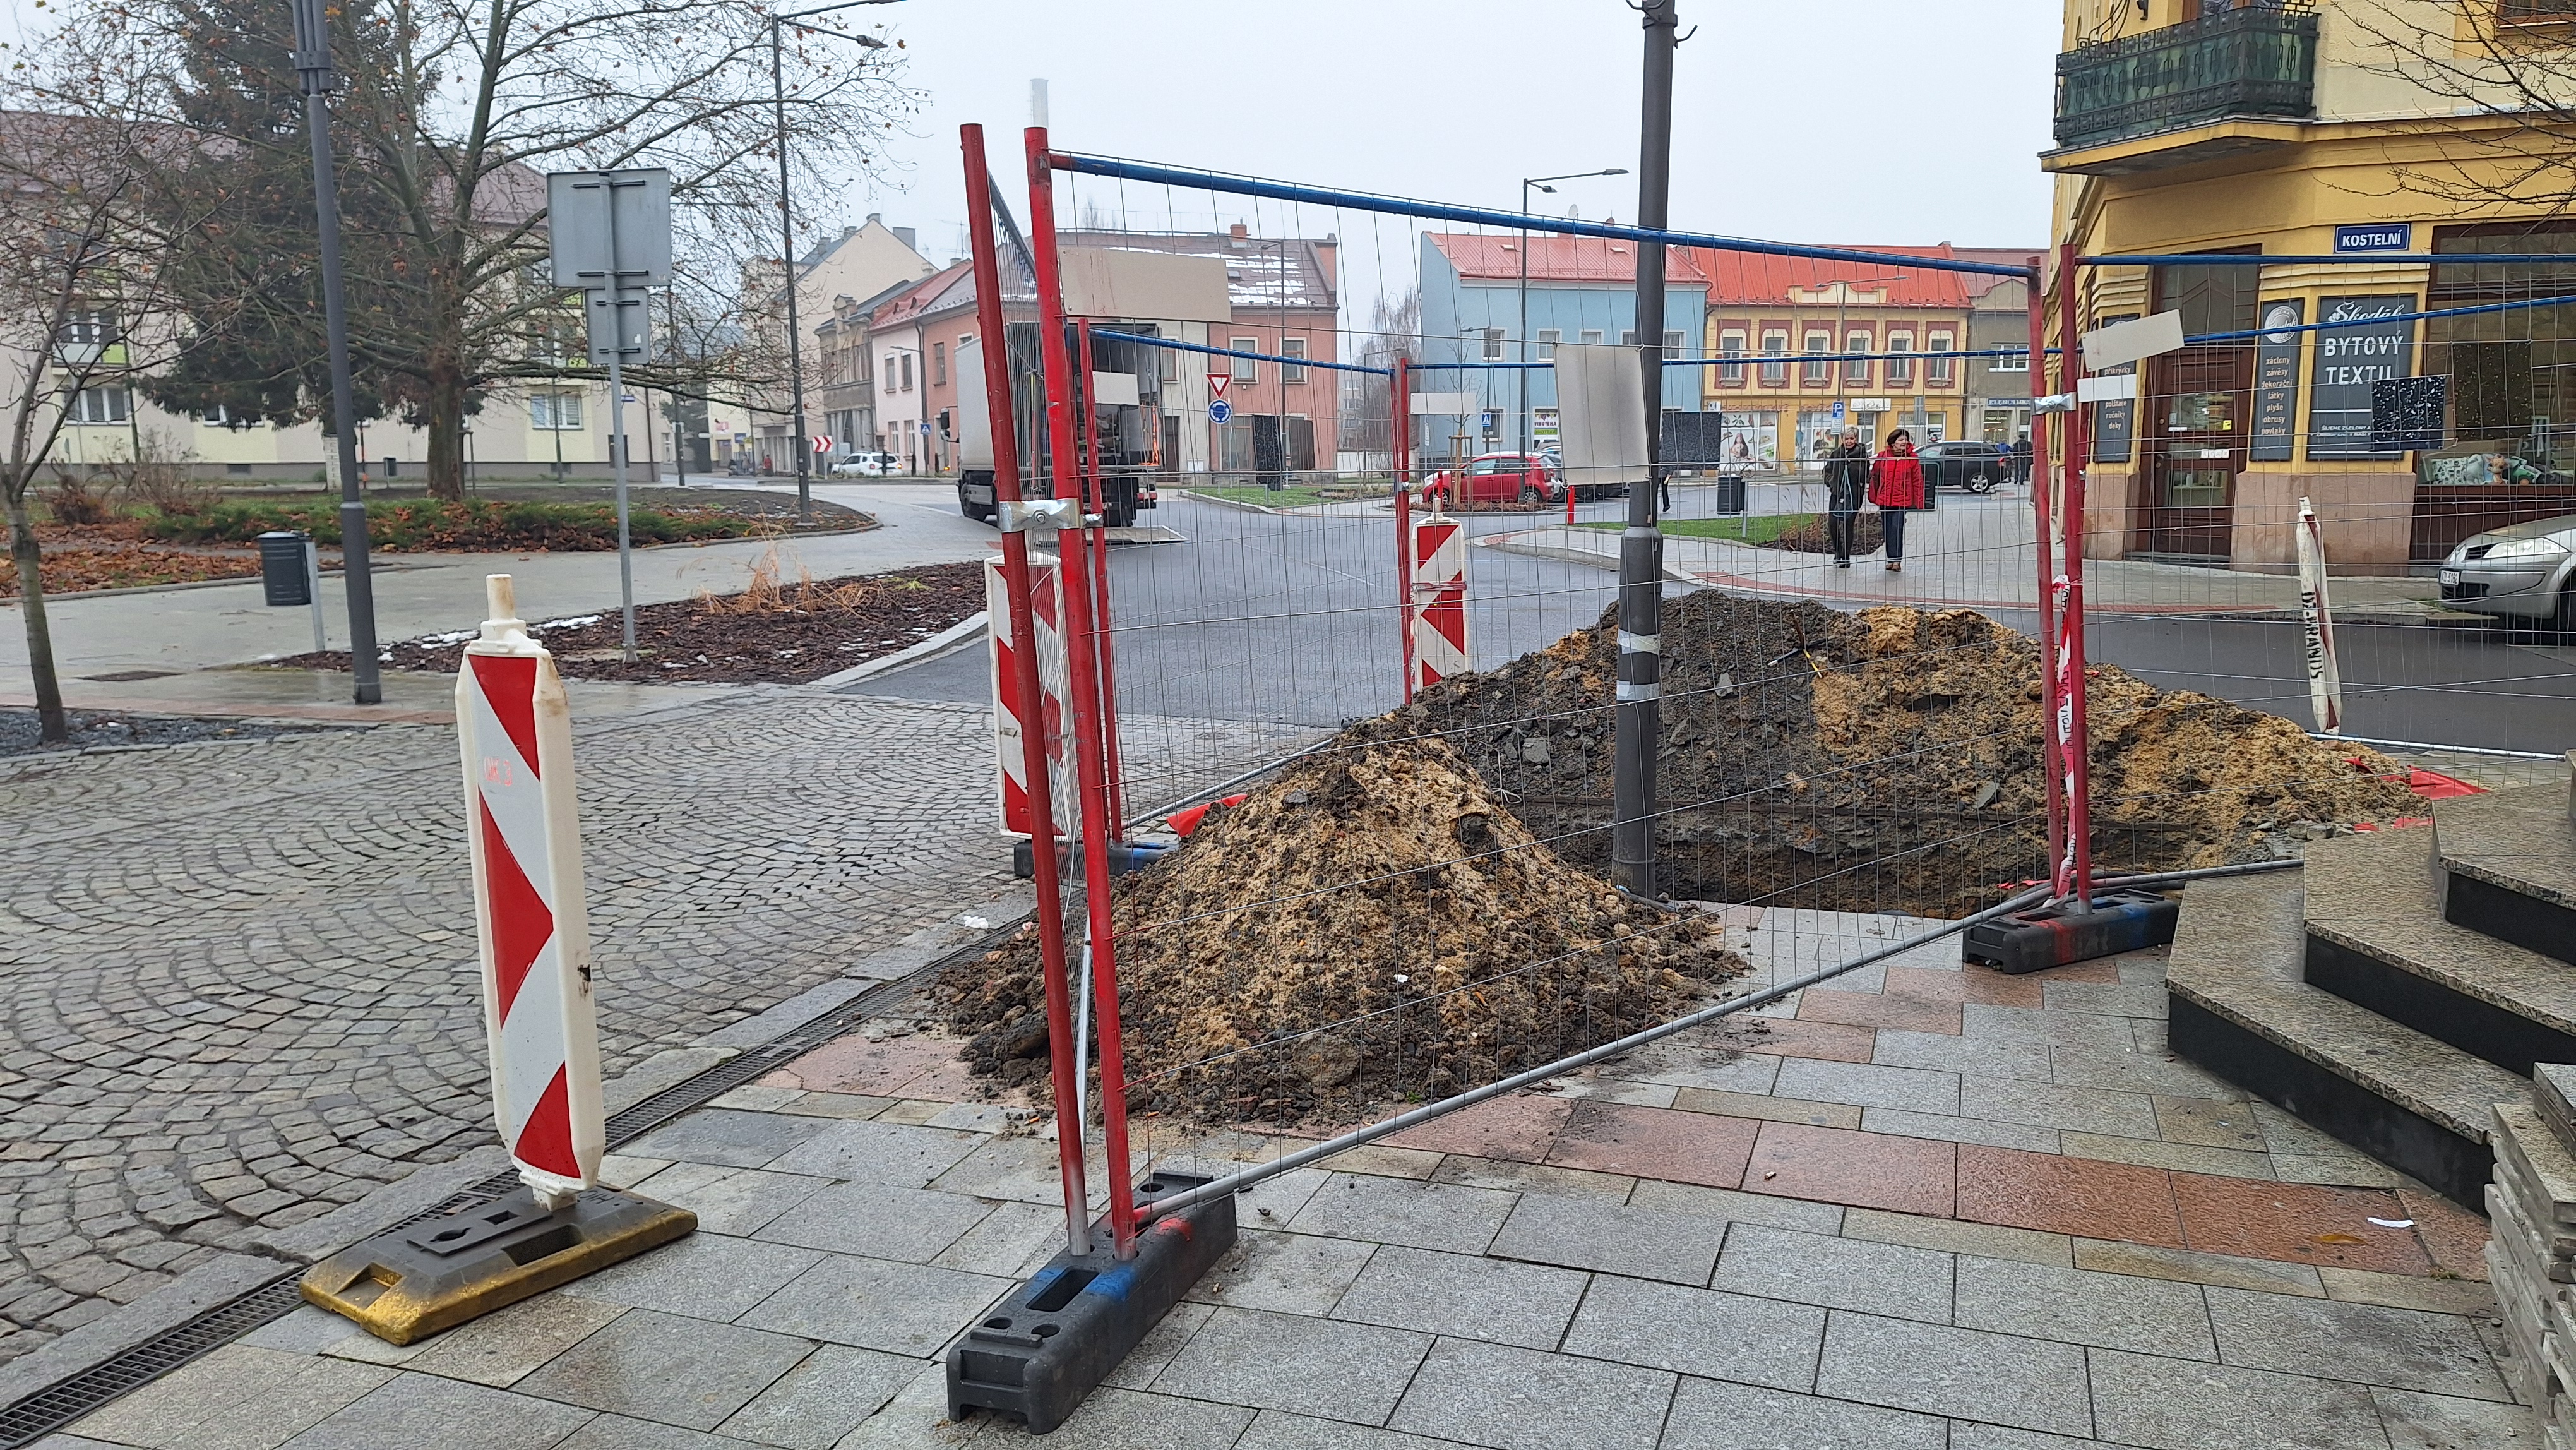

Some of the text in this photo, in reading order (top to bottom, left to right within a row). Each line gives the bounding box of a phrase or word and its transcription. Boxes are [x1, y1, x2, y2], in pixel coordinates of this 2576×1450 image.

[2342, 229, 2403, 247] KOSTELNÍ
[2324, 330, 2404, 356] BYTOVÝ
[2265, 356, 2290, 365] záclony
[2266, 368, 2288, 376] závěsy
[2262, 379, 2293, 388] dekorační
[2267, 392, 2284, 400] látky
[2266, 403, 2283, 412] plyše
[2263, 416, 2285, 424] obrusy
[2109, 421, 2121, 430] deky
[2261, 427, 2286, 435] povlaky
